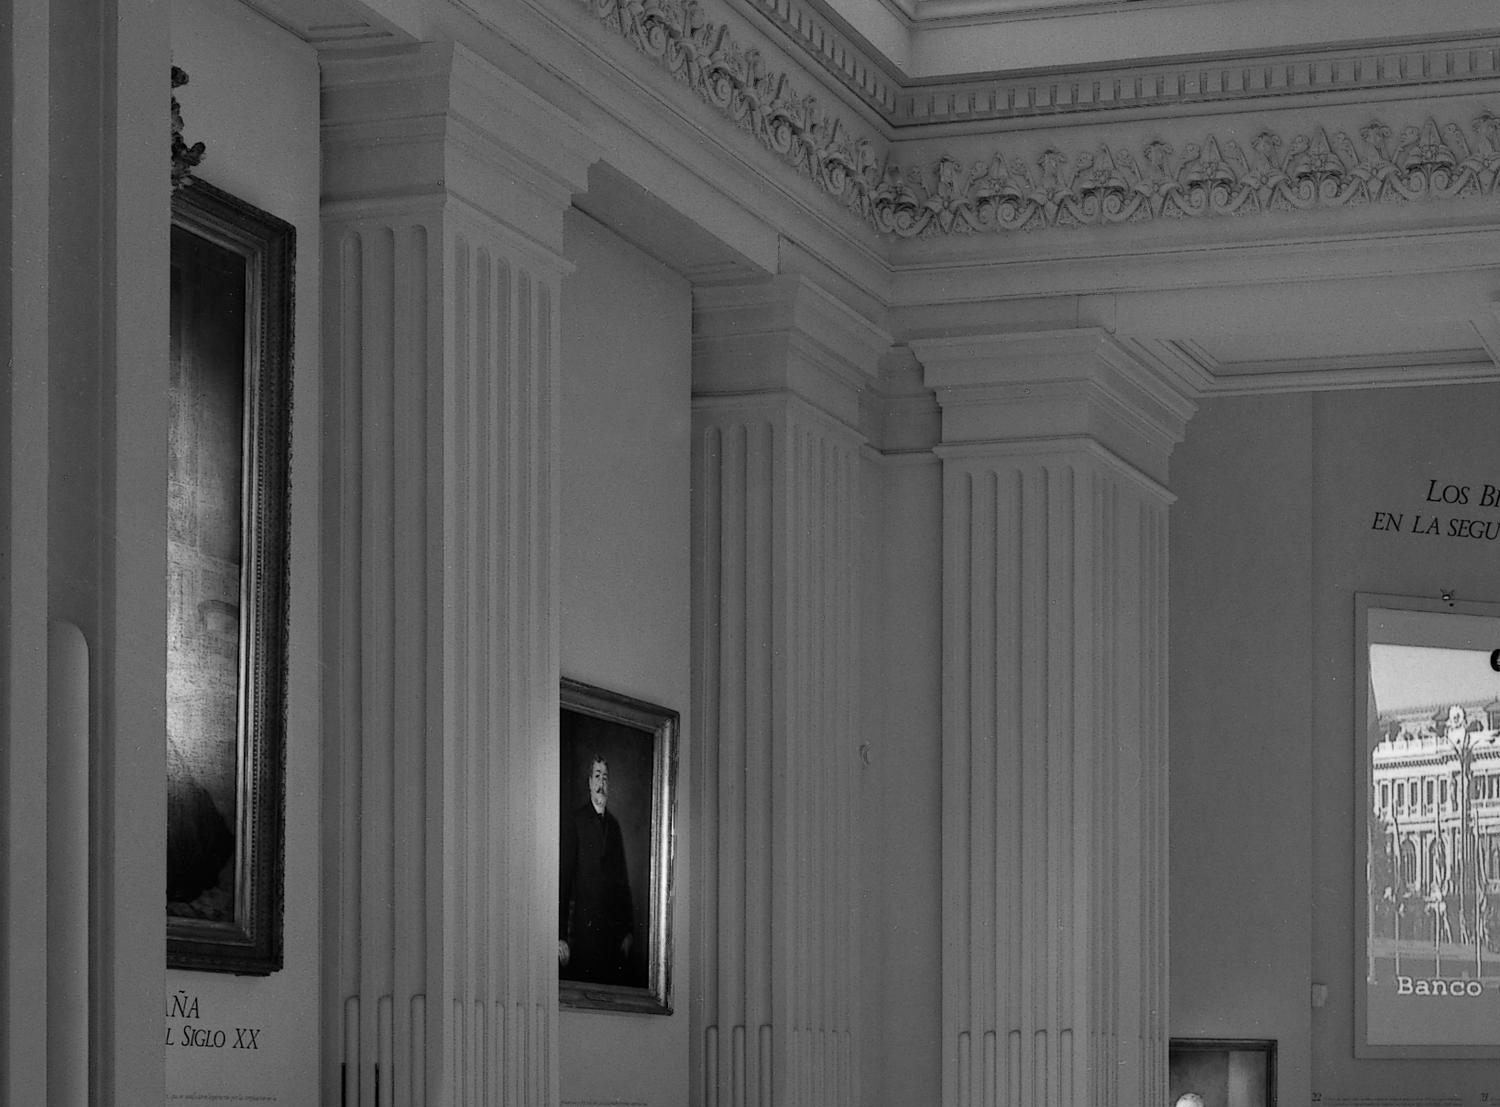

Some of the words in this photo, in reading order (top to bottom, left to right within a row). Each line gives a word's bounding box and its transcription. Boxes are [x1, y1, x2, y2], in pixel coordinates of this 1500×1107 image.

[1371, 511, 1404, 532] EN
[1411, 515, 1440, 535] LA
[1397, 976, 1482, 997] Banco
[181, 1025, 226, 1048] SIGLO
[232, 1027, 261, 1050] XX
